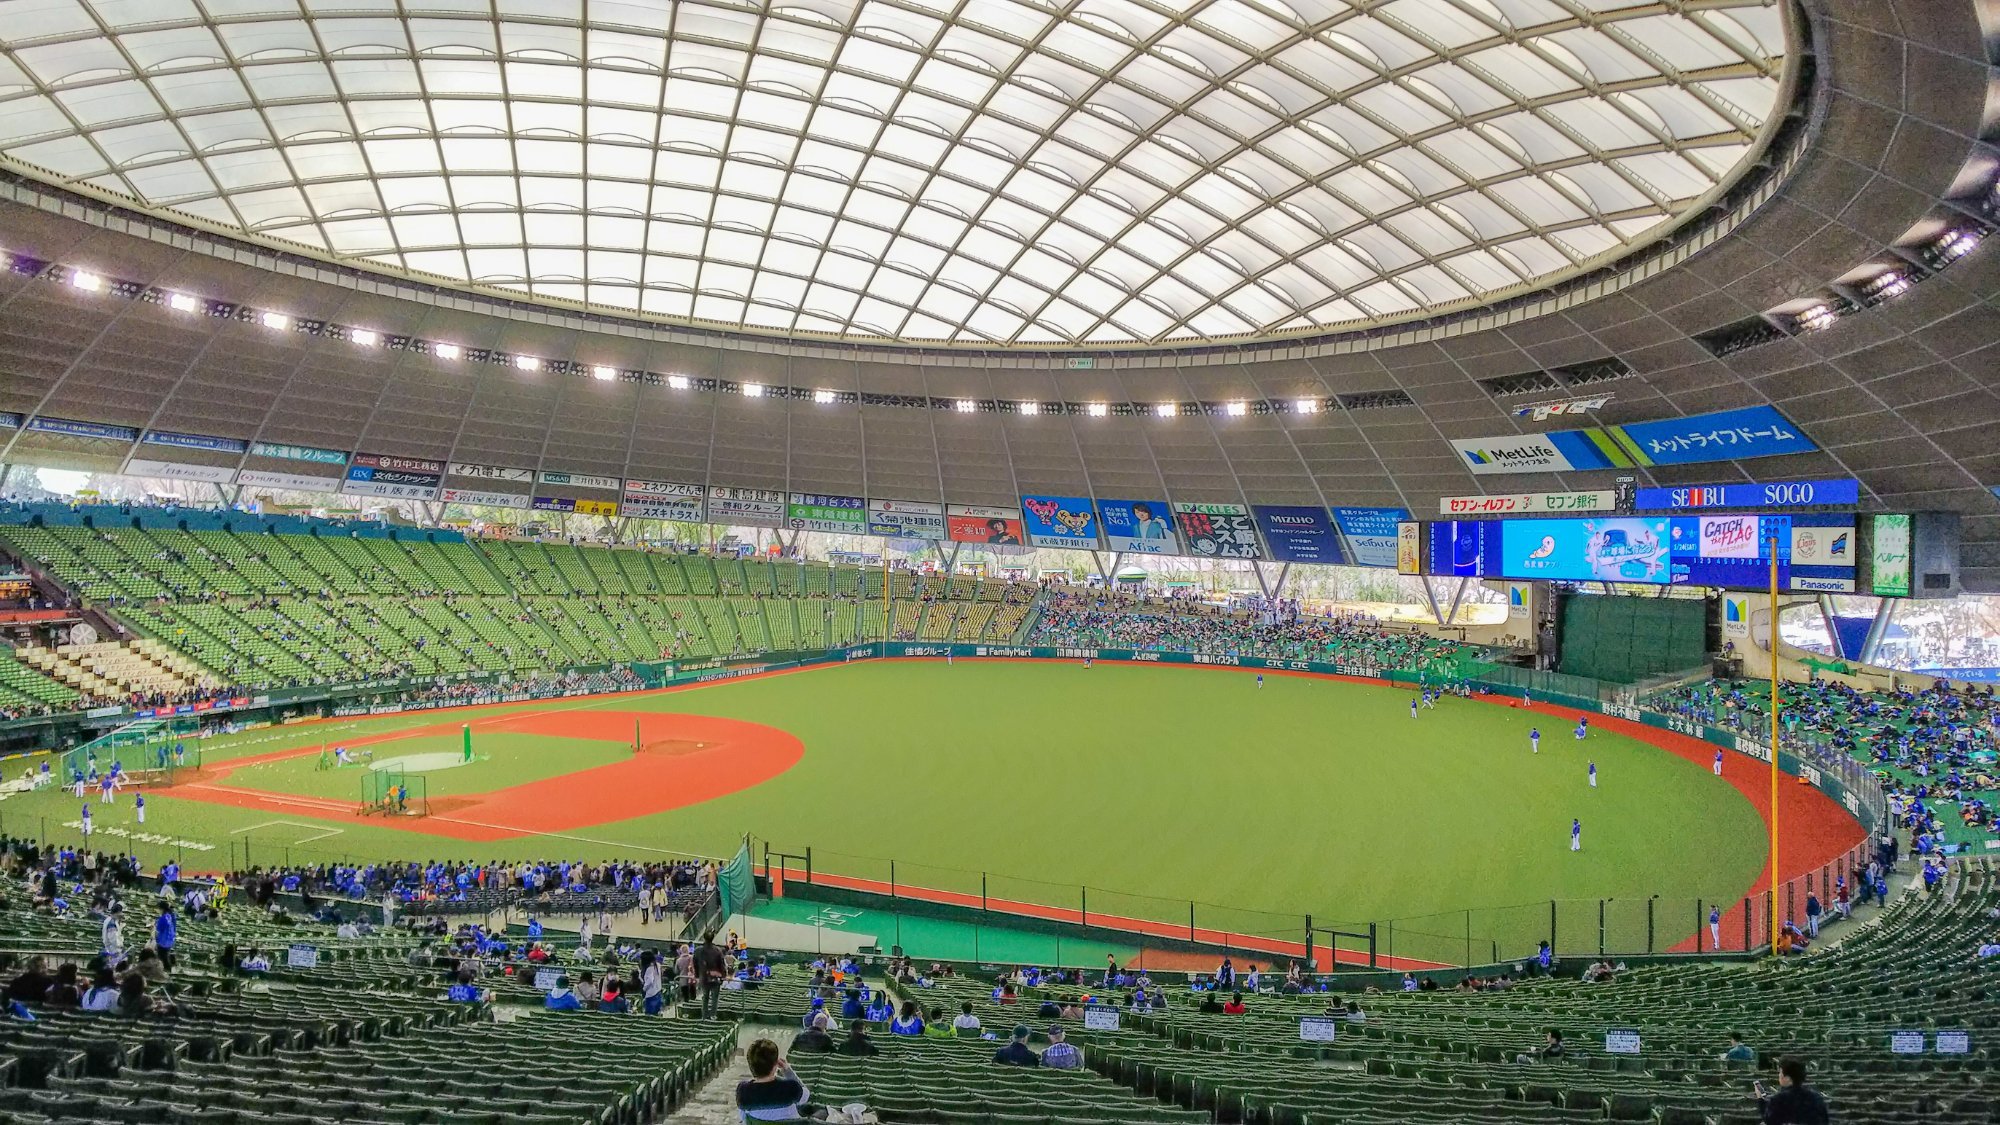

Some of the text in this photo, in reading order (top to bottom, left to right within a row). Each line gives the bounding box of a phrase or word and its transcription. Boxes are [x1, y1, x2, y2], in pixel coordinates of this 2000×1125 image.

[1649, 425, 1795, 453] メットライフドーム
[1491, 446, 1554, 461] MetLife
[392, 459, 439, 471] 竹中工務店
[352, 469, 369, 478] BX
[469, 466, 506, 479] 九電工
[642, 482, 703, 496] エネワンでんき
[1765, 483, 1814, 504] SOGO
[805, 494, 862, 508] 駿河台大学
[1546, 495, 1598, 508] セブン銀行
[1671, 487, 1725, 507] SEIBU
[642, 508, 700, 520] スズキトラスト
[1269, 515, 1315, 525] MIZUHO
[809, 519, 863, 532] 竹中土木
[885, 515, 942, 527] 菊池建設
[1107, 517, 1131, 526] No.1
[1704, 518, 1744, 538] CATCH
[1721, 524, 1754, 546] FLAG
[1039, 538, 1091, 548] 武蔵野銀行
[1128, 542, 1161, 552] Aflac
[1356, 538, 1384, 548] Seibu
[1800, 580, 1844, 589] Panasonic
[1727, 622, 1746, 631] MetLife
[989, 648, 1032, 657] FamilyMart
[1193, 654, 1240, 666] 東進ハイスクール
[1290, 661, 1309, 669] CTC
[1335, 665, 1381, 678] 三井住友銀行
[1602, 702, 1641, 722] 野村不動産
